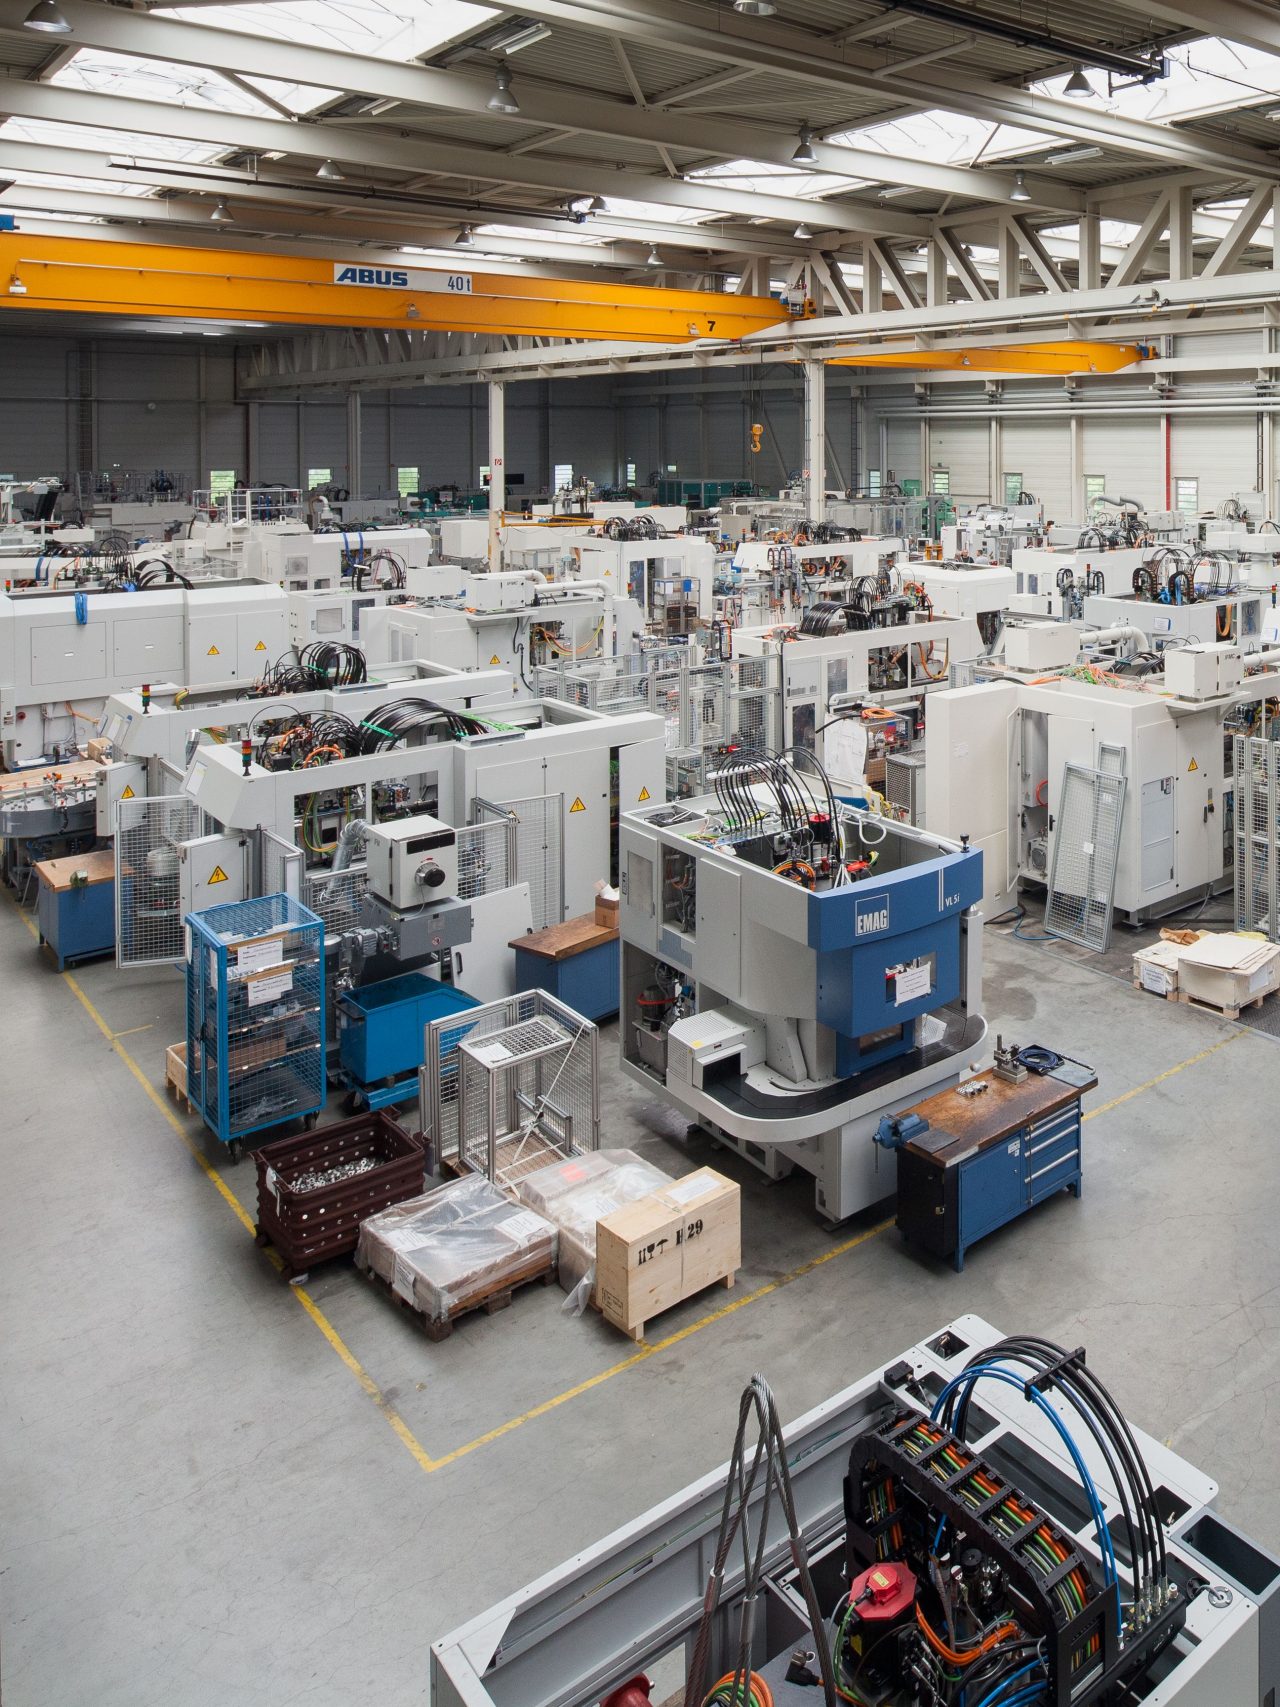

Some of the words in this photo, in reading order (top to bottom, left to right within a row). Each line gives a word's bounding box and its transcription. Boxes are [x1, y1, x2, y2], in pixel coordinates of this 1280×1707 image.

[336, 267, 408, 287] ABUS
[707, 320, 716, 332] 7
[945, 898, 953, 907] VL
[857, 909, 888, 934] EMAG
